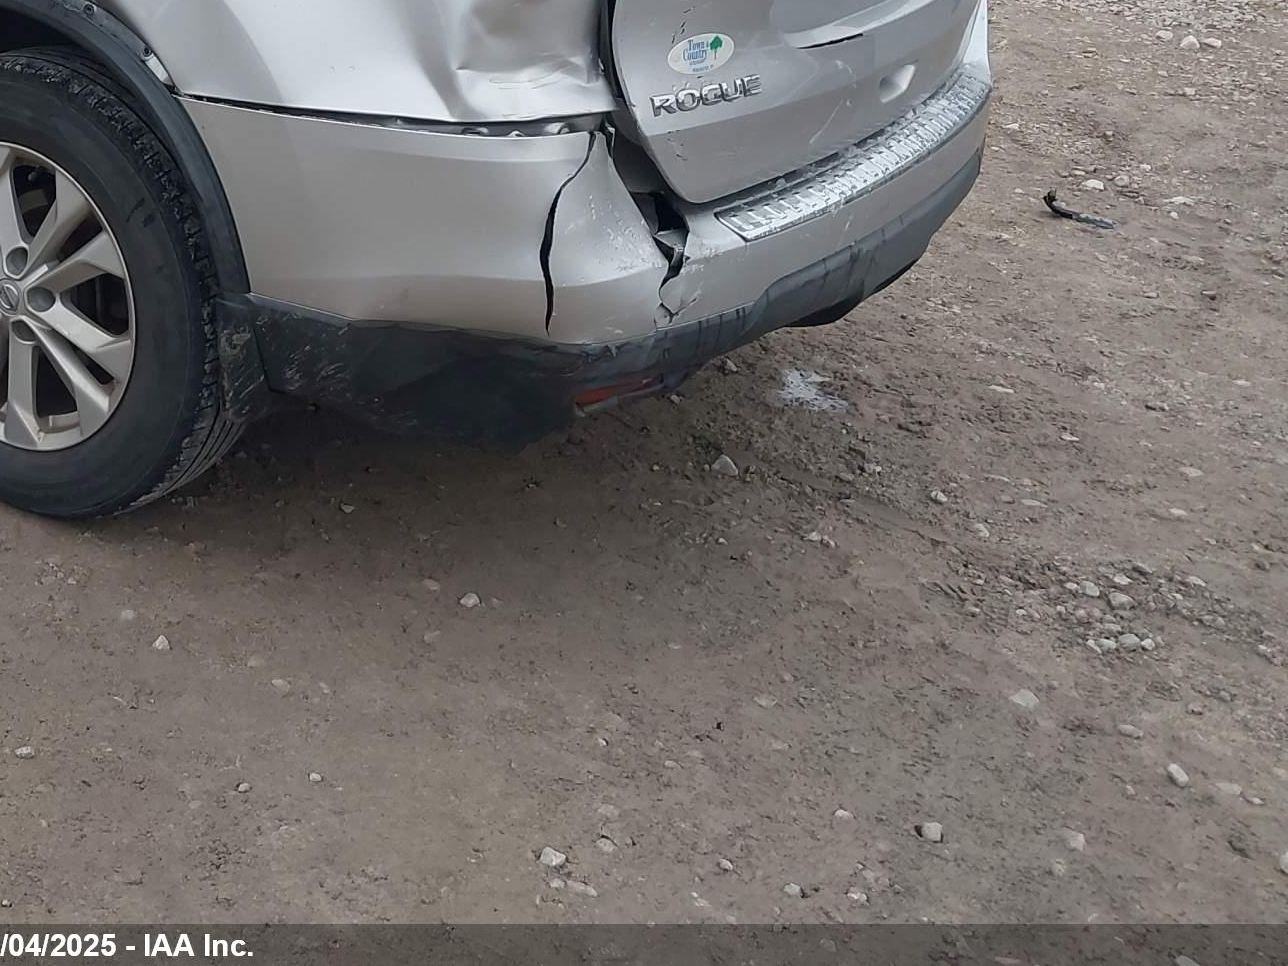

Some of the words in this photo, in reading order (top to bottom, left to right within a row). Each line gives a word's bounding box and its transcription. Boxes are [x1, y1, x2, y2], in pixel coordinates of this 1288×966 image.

[688, 39, 705, 50] Town
[683, 49, 707, 61] Country
[649, 74, 763, 117] ROGUE
